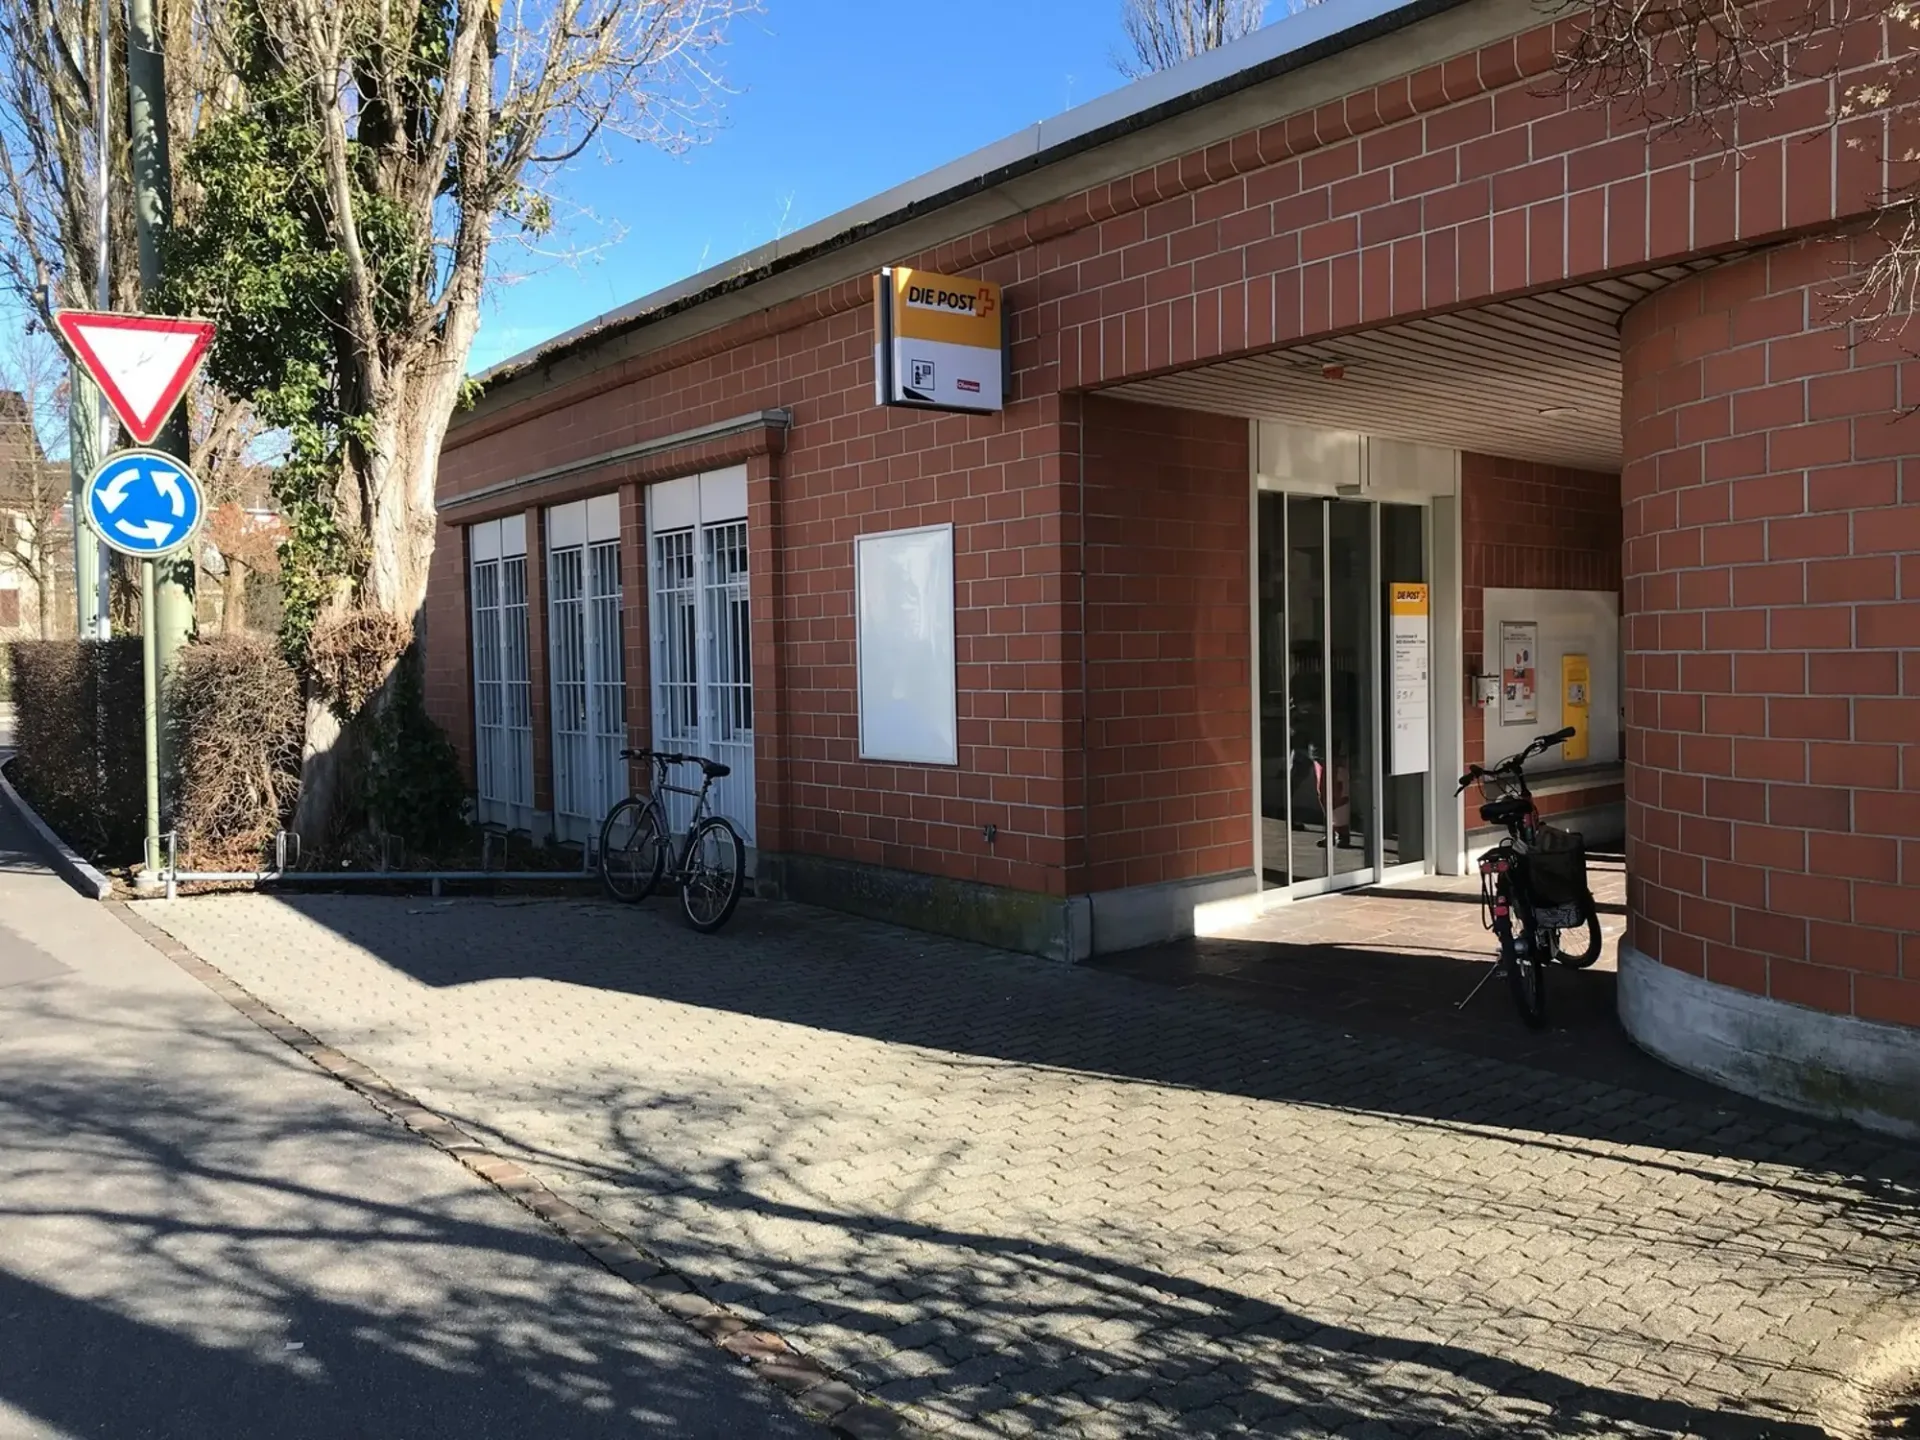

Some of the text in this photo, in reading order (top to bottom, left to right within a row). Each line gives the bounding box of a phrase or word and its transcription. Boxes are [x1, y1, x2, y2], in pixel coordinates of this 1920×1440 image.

[908, 286, 977, 311] DIE POST
[1397, 590, 1420, 600] DIE POST
